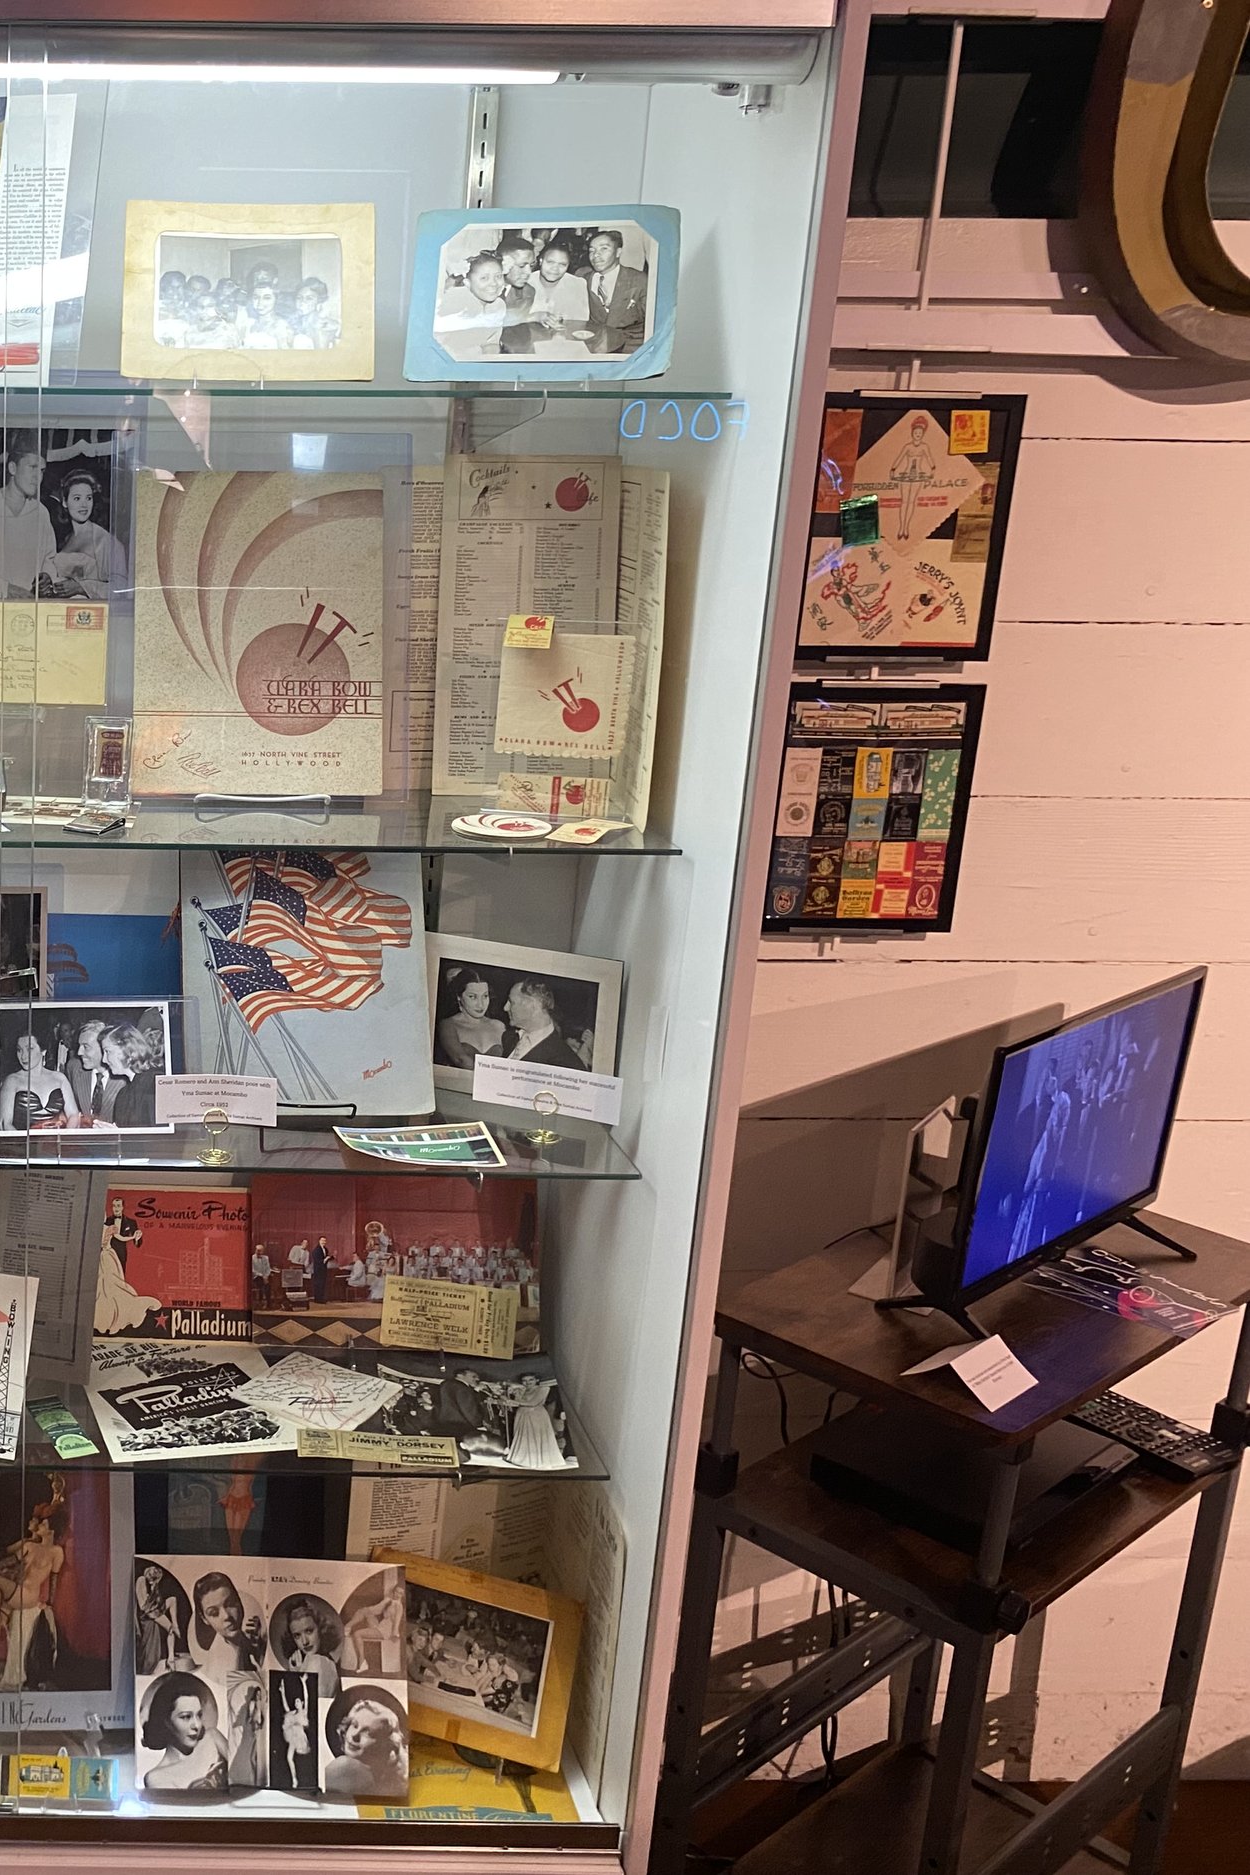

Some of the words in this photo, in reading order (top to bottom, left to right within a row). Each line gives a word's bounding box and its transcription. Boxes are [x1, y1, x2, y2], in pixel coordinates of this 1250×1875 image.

[469, 464, 511, 488] Cocktails
[853, 481, 899, 491] FORBIDDEN
[923, 478, 968, 489] PALACE
[914, 561, 955, 590] JERRY'S
[950, 592, 966, 626] JOYNT
[614, 645, 625, 685] HOLLYWOOD
[267, 675, 322, 697] CLARA
[332, 681, 373, 697] BOW
[331, 699, 373, 715] BELL
[491, 1064, 510, 1072] Sumac
[516, 1067, 553, 1079] congratulated
[553, 1073, 579, 1084] following
[589, 1080, 616, 1091] successful
[511, 1075, 546, 1086] performance
[553, 1081, 580, 1091] Mocambo
[135, 1197, 201, 1221] Souvenir
[202, 1200, 250, 1221] Photo
[168, 1223, 214, 1231] MARVELOUS
[398, 1286, 439, 1297] HALF-PRICE
[442, 1292, 466, 1300] TICKET
[172, 1299, 194, 1307] WORLD
[195, 1300, 222, 1308] FAMOUS
[424, 1300, 470, 1311] PALLADIUM
[171, 1309, 252, 1338] Palladium
[390, 1317, 440, 1330] LAWRENCE
[443, 1324, 469, 1334] WELK
[3, 1304, 16, 1364] BOWLING
[124, 1346, 139, 1355] OF
[99, 1357, 136, 1371] Always
[139, 1410, 174, 1421] AMERICA'S
[175, 1404, 199, 1414] FINEST
[349, 1437, 389, 1447] JIMMY
[397, 1441, 446, 1449] DORSEY
[401, 1455, 453, 1463] PALLADIUM
[21, 1702, 67, 1732] Gardens
[424, 1761, 472, 1783] Evening
[390, 1809, 479, 1820] FLORENTINE
